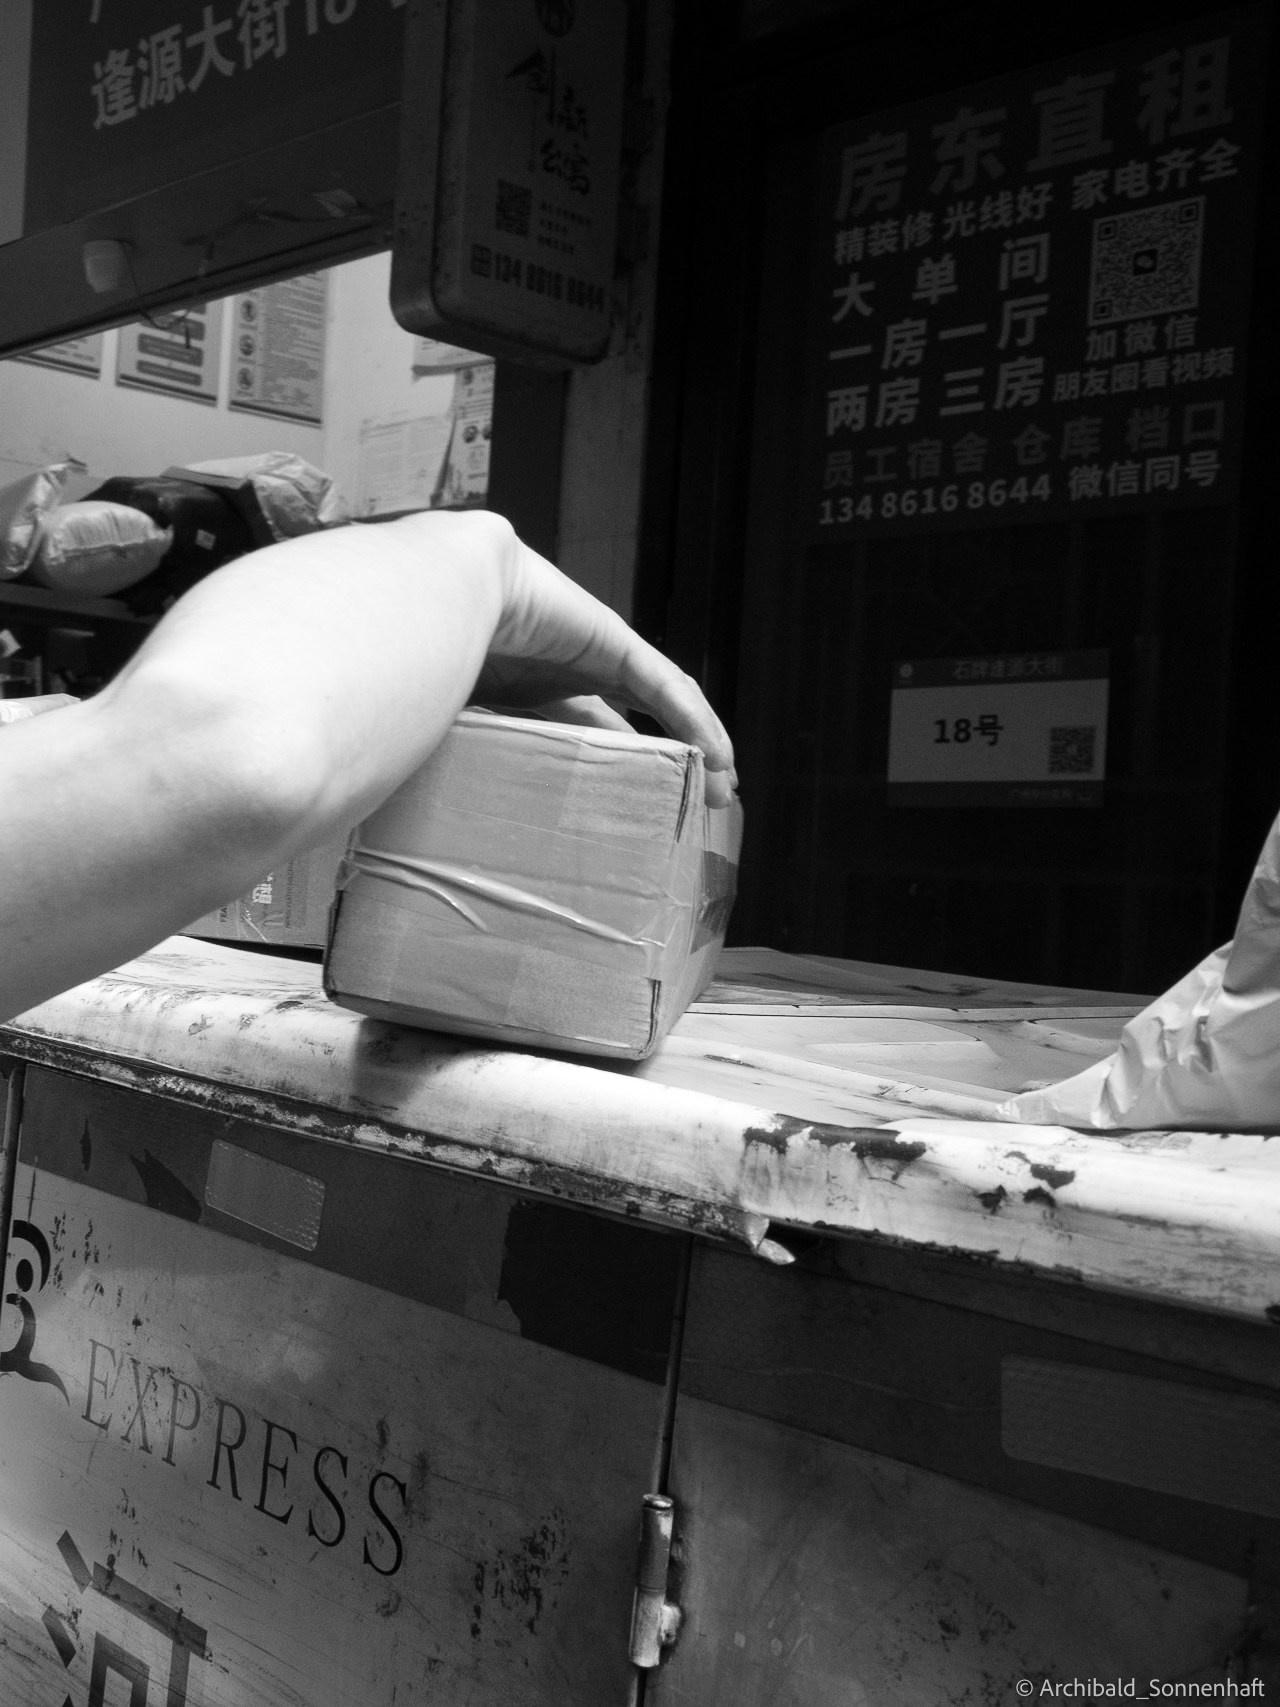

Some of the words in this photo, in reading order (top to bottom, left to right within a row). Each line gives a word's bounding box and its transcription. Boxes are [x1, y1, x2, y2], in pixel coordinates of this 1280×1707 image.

[834, 36, 1234, 222] 房东直租
[1072, 138, 1242, 211] 家电齐全
[834, 211, 934, 266] 精装修
[944, 182, 1054, 242] 光线好
[831, 232, 1051, 323] 大单间
[828, 295, 1050, 371] 一房一厅
[1085, 315, 1198, 362] 加微信
[826, 377, 922, 436] 两房
[939, 356, 1045, 417] 三房
[1052, 346, 1235, 403] 朋友圈看视频
[822, 432, 989, 490] 员工宿舍
[1012, 416, 1104, 468] 仓库
[1126, 400, 1225, 453] 档口
[819, 492, 872, 526] 134
[881, 485, 959, 519] 8616
[967, 473, 1052, 510] 8644
[1068, 449, 1222, 502] 微信同号
[933, 714, 1004, 747] 18号
[80, 1337, 409, 1577] EXPRESS
